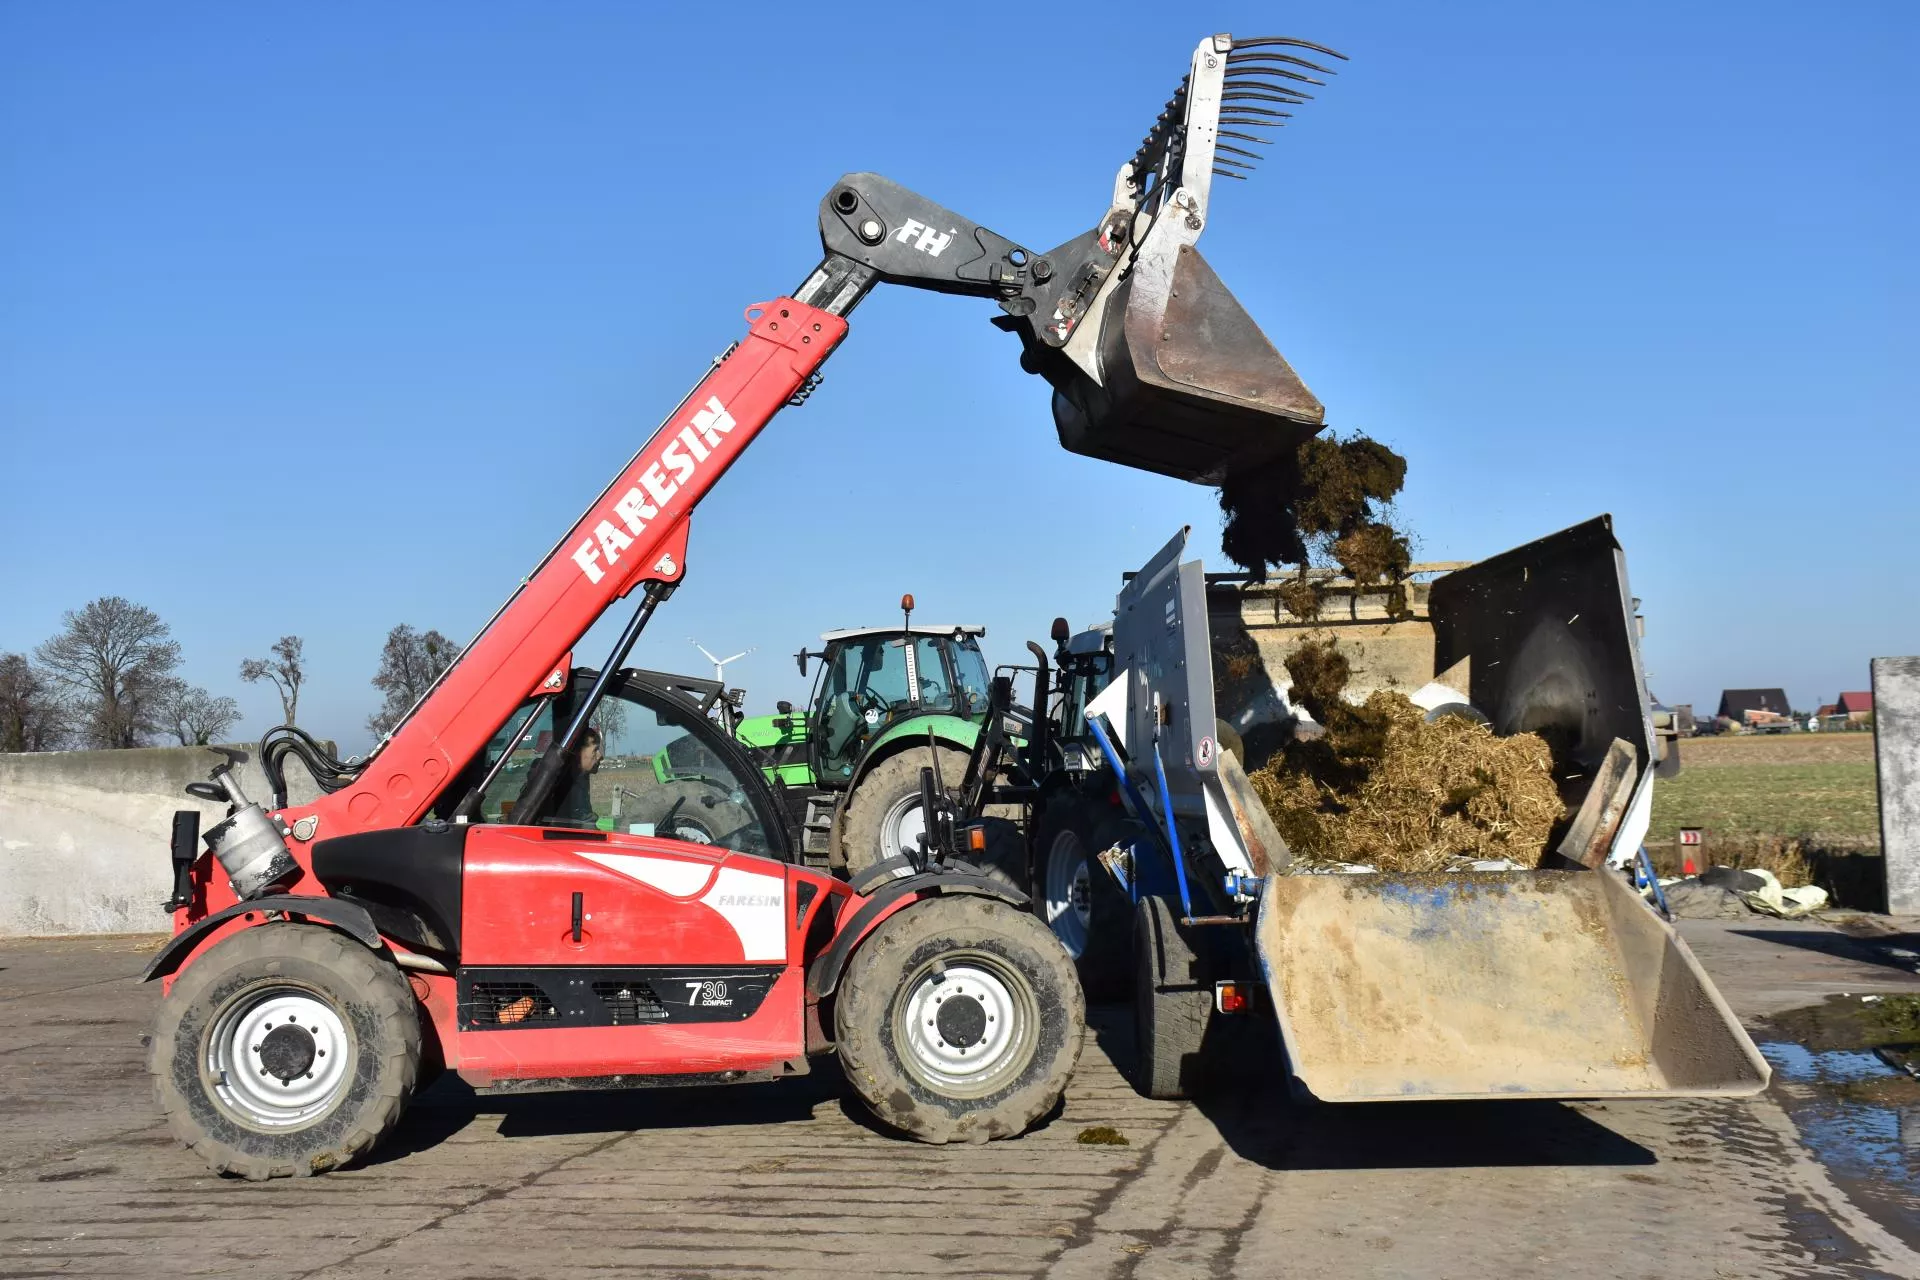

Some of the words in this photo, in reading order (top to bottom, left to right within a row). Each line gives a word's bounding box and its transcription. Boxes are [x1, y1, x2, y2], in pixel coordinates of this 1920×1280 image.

[896, 218, 951, 257] FH
[571, 395, 736, 584] FARESIN
[719, 895, 782, 907] FARESIN
[685, 981, 727, 1006] 730
[702, 999, 733, 1007] COMPACT
